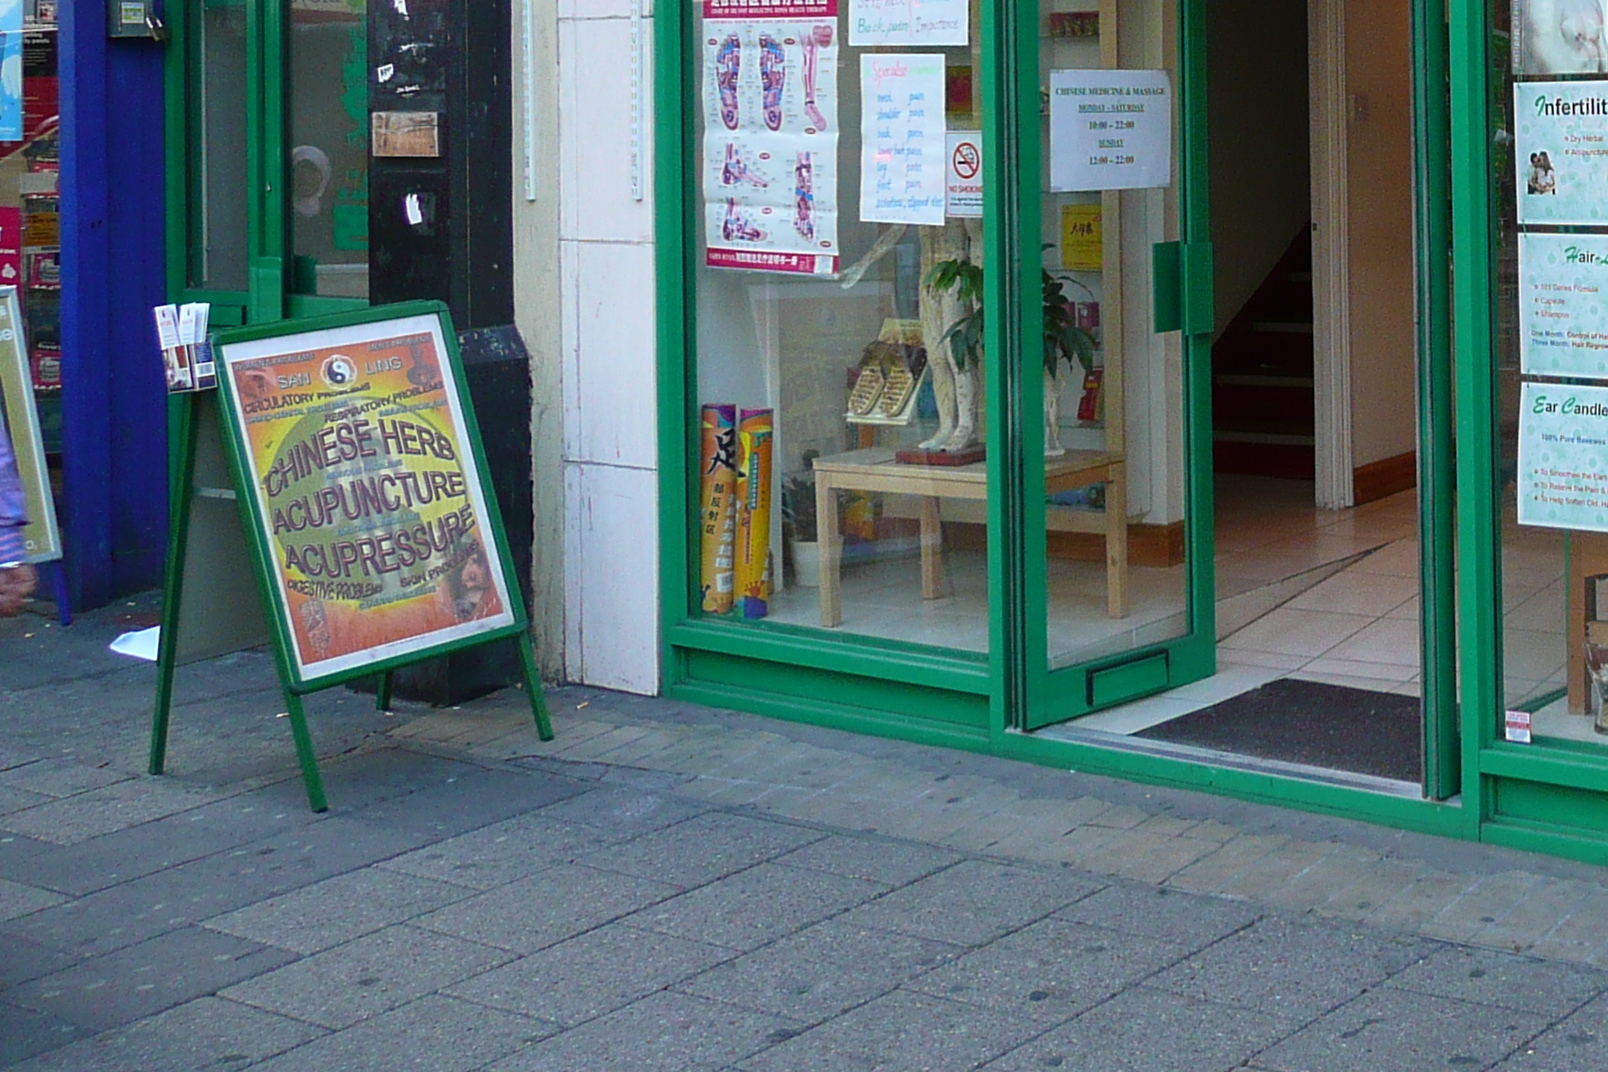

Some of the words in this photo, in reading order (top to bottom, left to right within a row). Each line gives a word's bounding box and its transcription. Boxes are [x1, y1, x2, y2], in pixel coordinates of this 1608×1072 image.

[277, 371, 311, 390] SAN
[365, 356, 403, 376] LING
[244, 392, 315, 415] CIRCULATORY
[324, 395, 392, 424] RESPIRATORY
[1532, 396, 1558, 414] Ear
[264, 420, 376, 498] CHINESE
[377, 419, 455, 461] HERB
[274, 470, 466, 535] ACUPUNCTURE
[285, 503, 475, 578] ACUPRESSURE
[400, 573, 426, 588] SKIN
